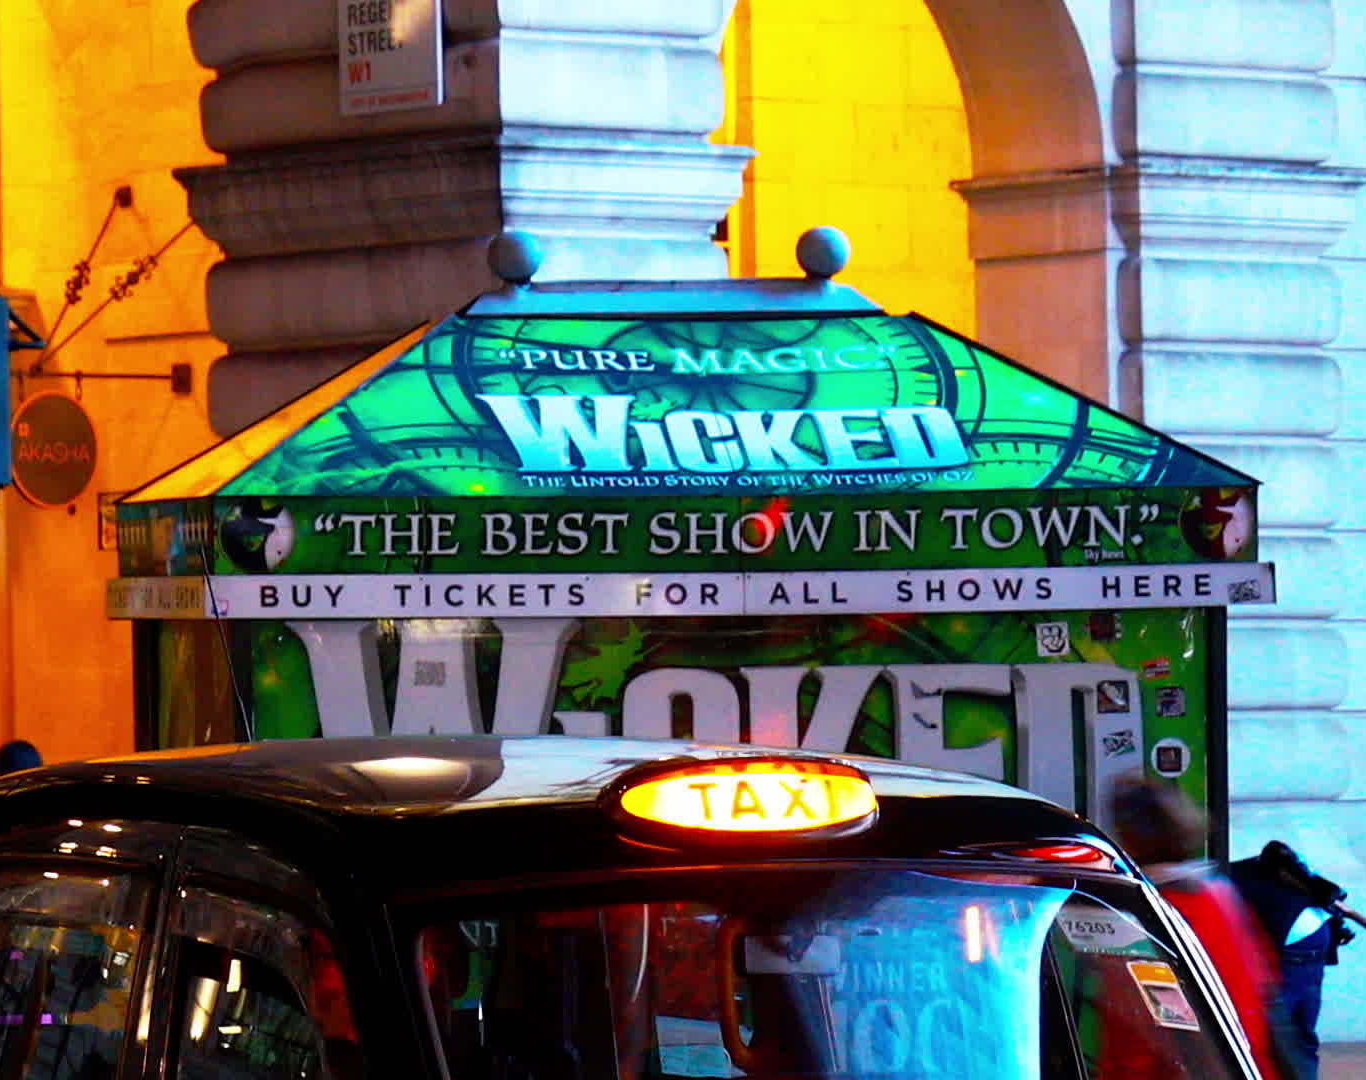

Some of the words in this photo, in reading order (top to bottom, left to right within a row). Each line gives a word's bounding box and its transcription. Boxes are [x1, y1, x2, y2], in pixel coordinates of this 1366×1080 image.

[347, 2, 394, 28] REGE
[348, 61, 372, 86] W1
[522, 475, 565, 488] THE
[570, 475, 660, 488] UNTOLD
[663, 474, 730, 488] STORY
[736, 475, 761, 487] OF
[807, 472, 907, 486] WITCHES
[942, 469, 976, 482] OZ
[481, 512, 630, 556] BEST
[648, 509, 836, 557] SHOW
[852, 508, 922, 553] IN
[259, 583, 346, 609] BUY
[394, 582, 587, 608] TICKETS
[635, 580, 721, 607] FOR
[769, 581, 848, 605] ALL
[897, 576, 1054, 603] SHOWS
[1101, 573, 1213, 600] HERE
[687, 779, 841, 821] TAXI
